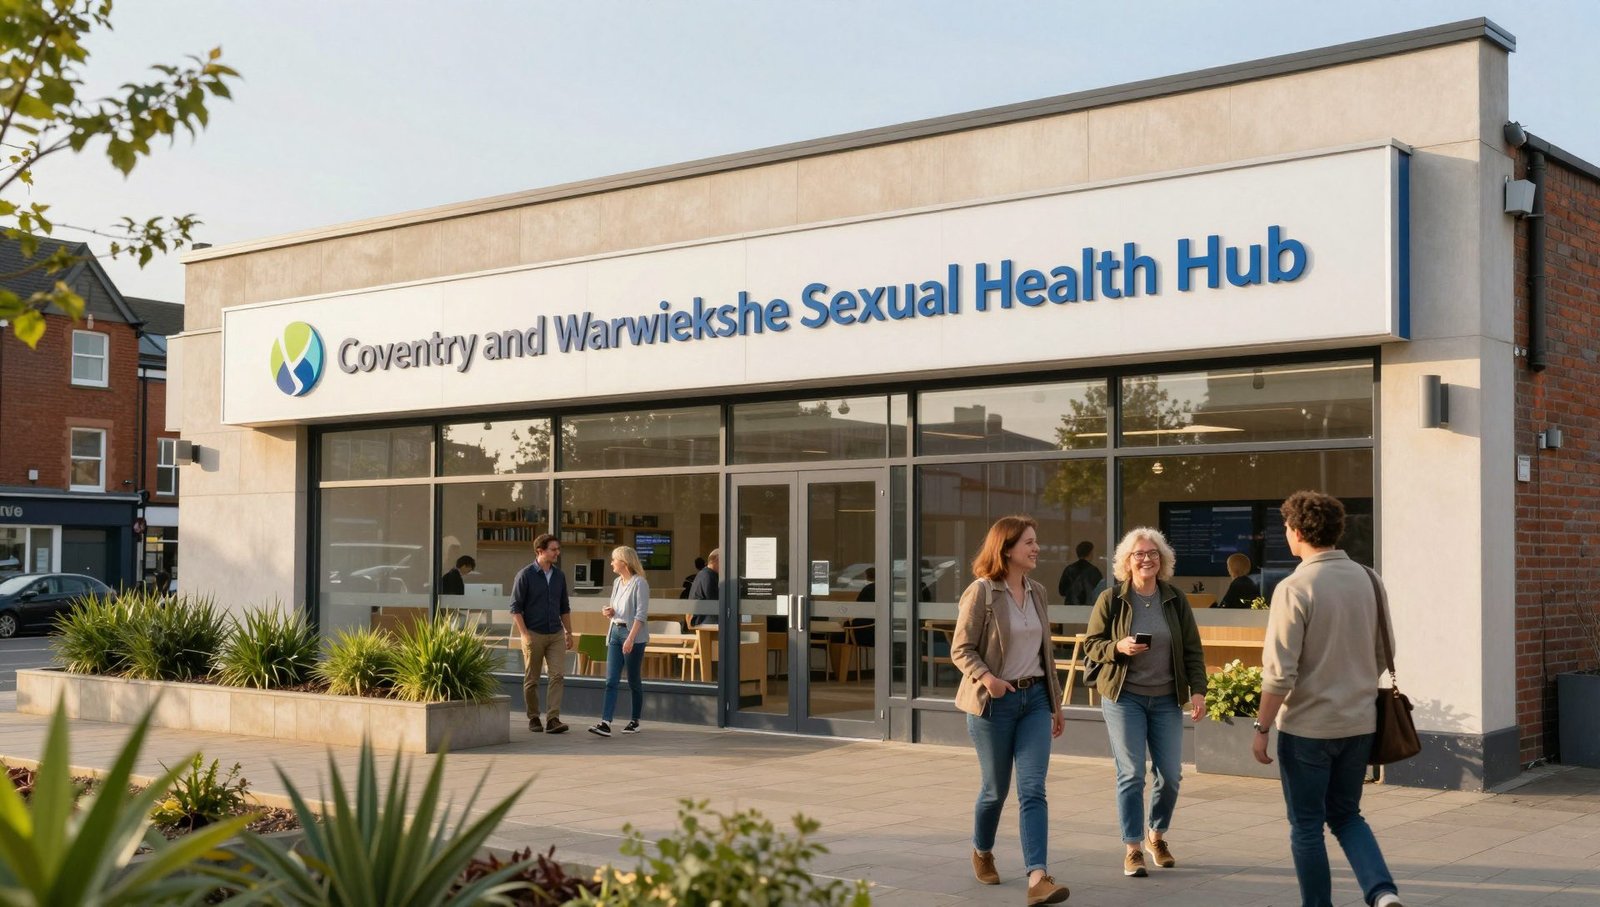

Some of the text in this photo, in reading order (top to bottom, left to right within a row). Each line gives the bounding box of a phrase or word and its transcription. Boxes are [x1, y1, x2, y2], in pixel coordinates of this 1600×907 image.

[337, 331, 478, 374] Coventry
[482, 315, 548, 361] and
[800, 263, 961, 329] Sexual
[975, 242, 1157, 311] Health
[1177, 225, 1309, 292] Hub
